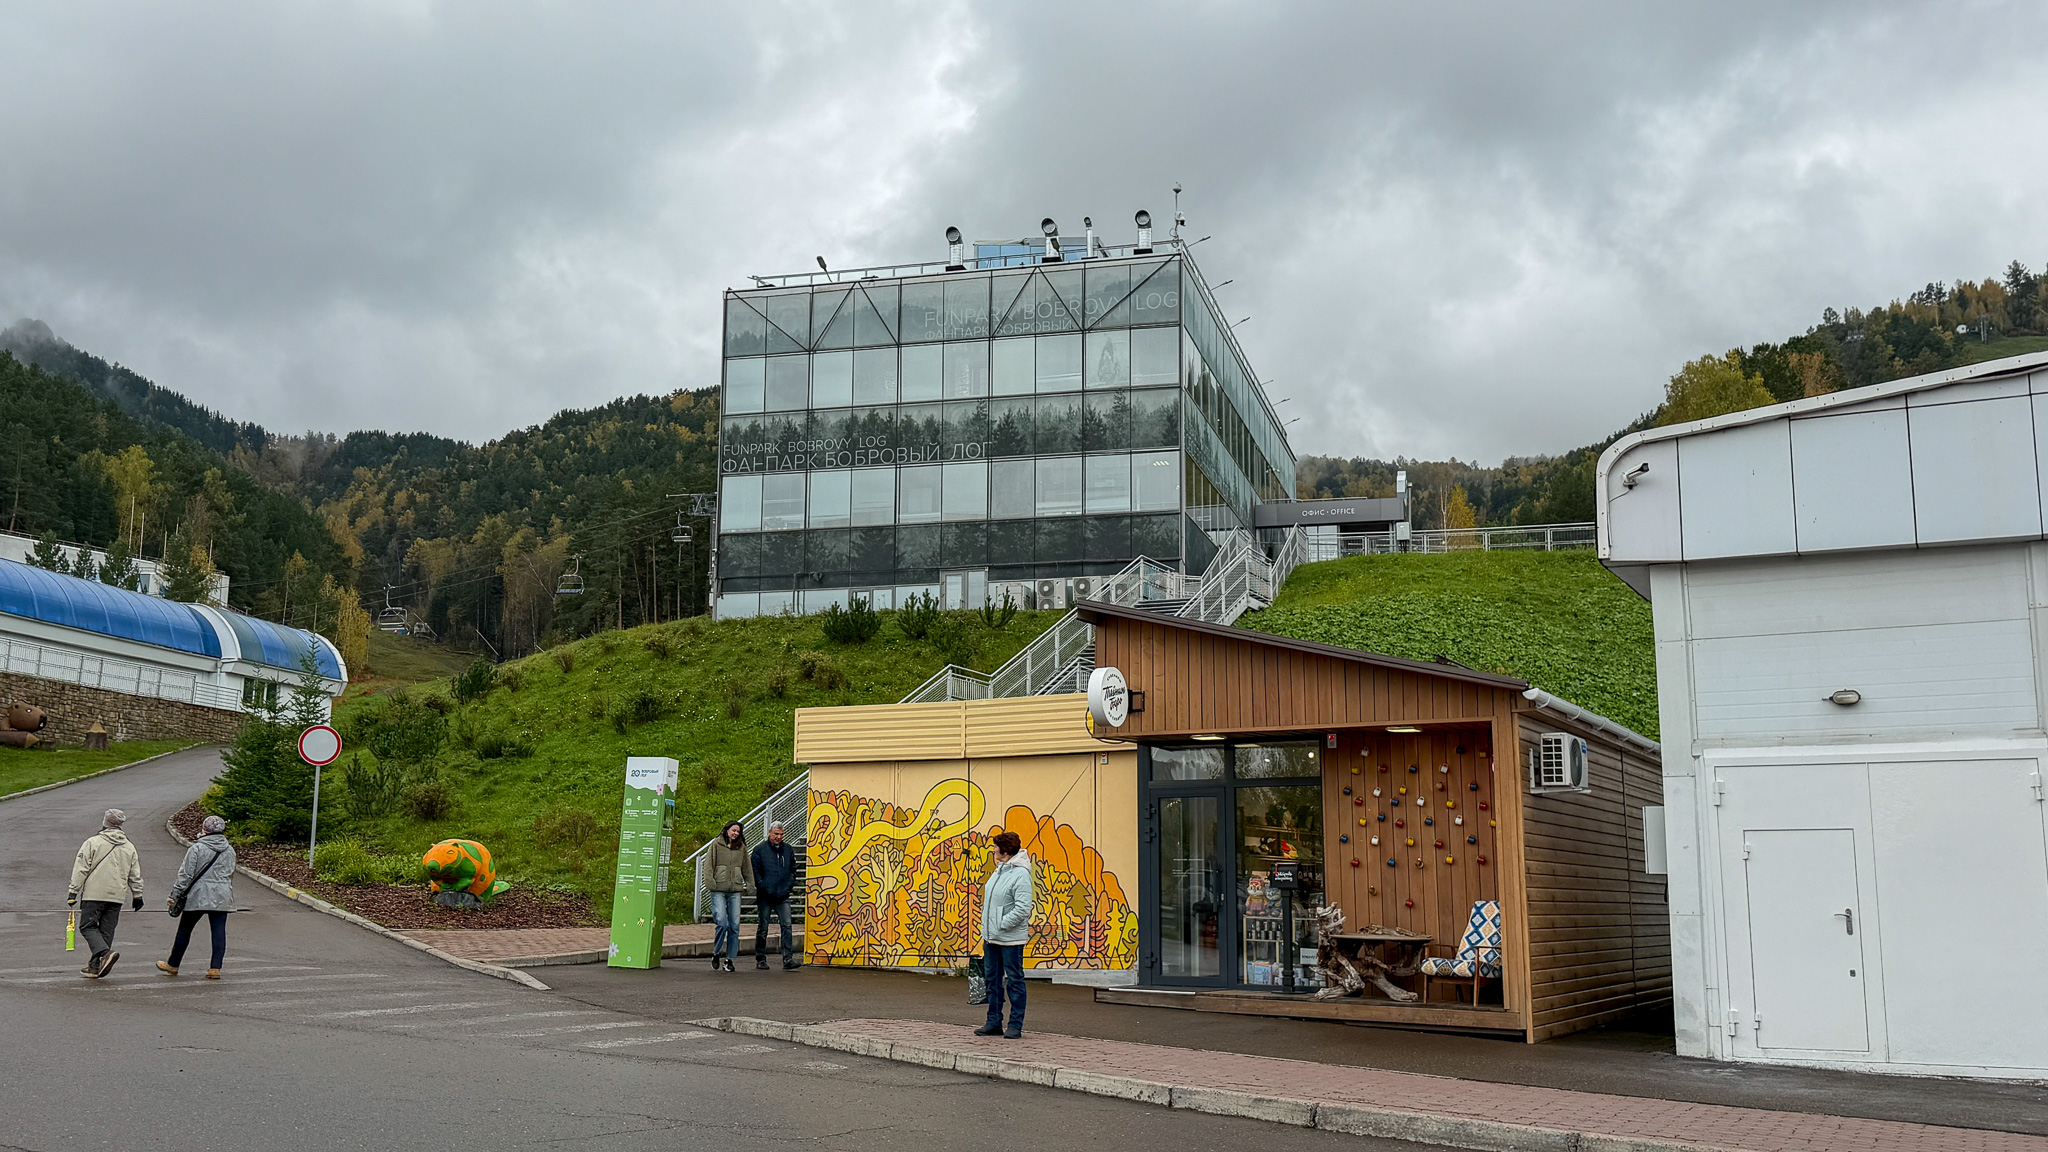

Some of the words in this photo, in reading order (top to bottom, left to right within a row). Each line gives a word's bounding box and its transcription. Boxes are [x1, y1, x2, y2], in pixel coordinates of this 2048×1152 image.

[925, 305, 1016, 328] FUNPARK
[1023, 296, 1125, 321] BOBROVY
[1135, 291, 1178, 311] LOG
[723, 442, 781, 456] FUNPARK
[788, 437, 852, 453] BOBROVY
[859, 435, 887, 448] LOG
[722, 453, 818, 473] ФАНПАРК
[825, 442, 940, 468] БОБРОВЫЙ
[950, 442, 993, 460] ЛОГ
[1301, 509, 1325, 517] ОФИС
[1330, 507, 1355, 515] OFFICE
